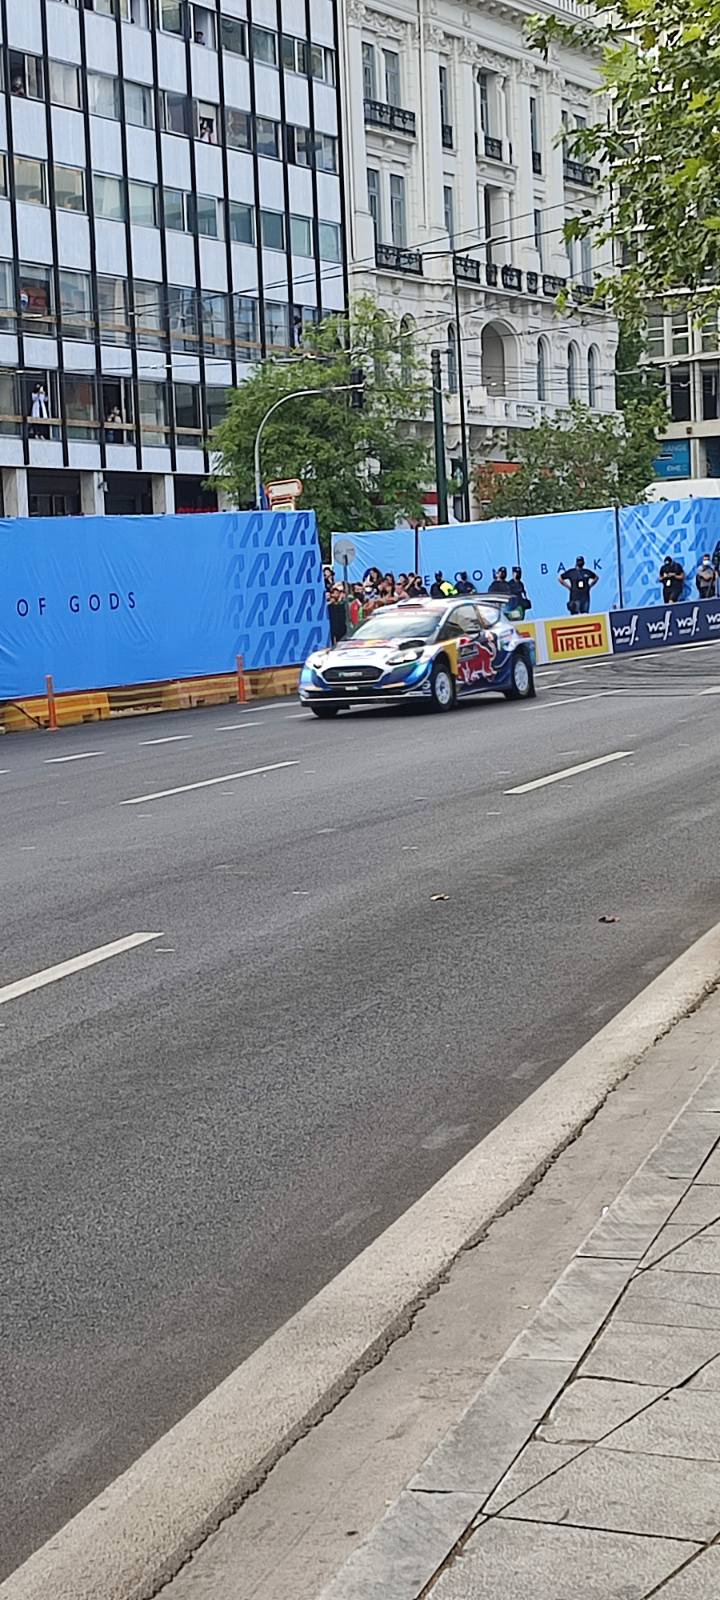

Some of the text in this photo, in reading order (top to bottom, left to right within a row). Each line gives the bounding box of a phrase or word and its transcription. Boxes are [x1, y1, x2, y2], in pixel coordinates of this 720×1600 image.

[540, 558, 602, 575] BAK
[16, 591, 136, 617] OF GODS
[551, 622, 604, 653] PIRELLI
